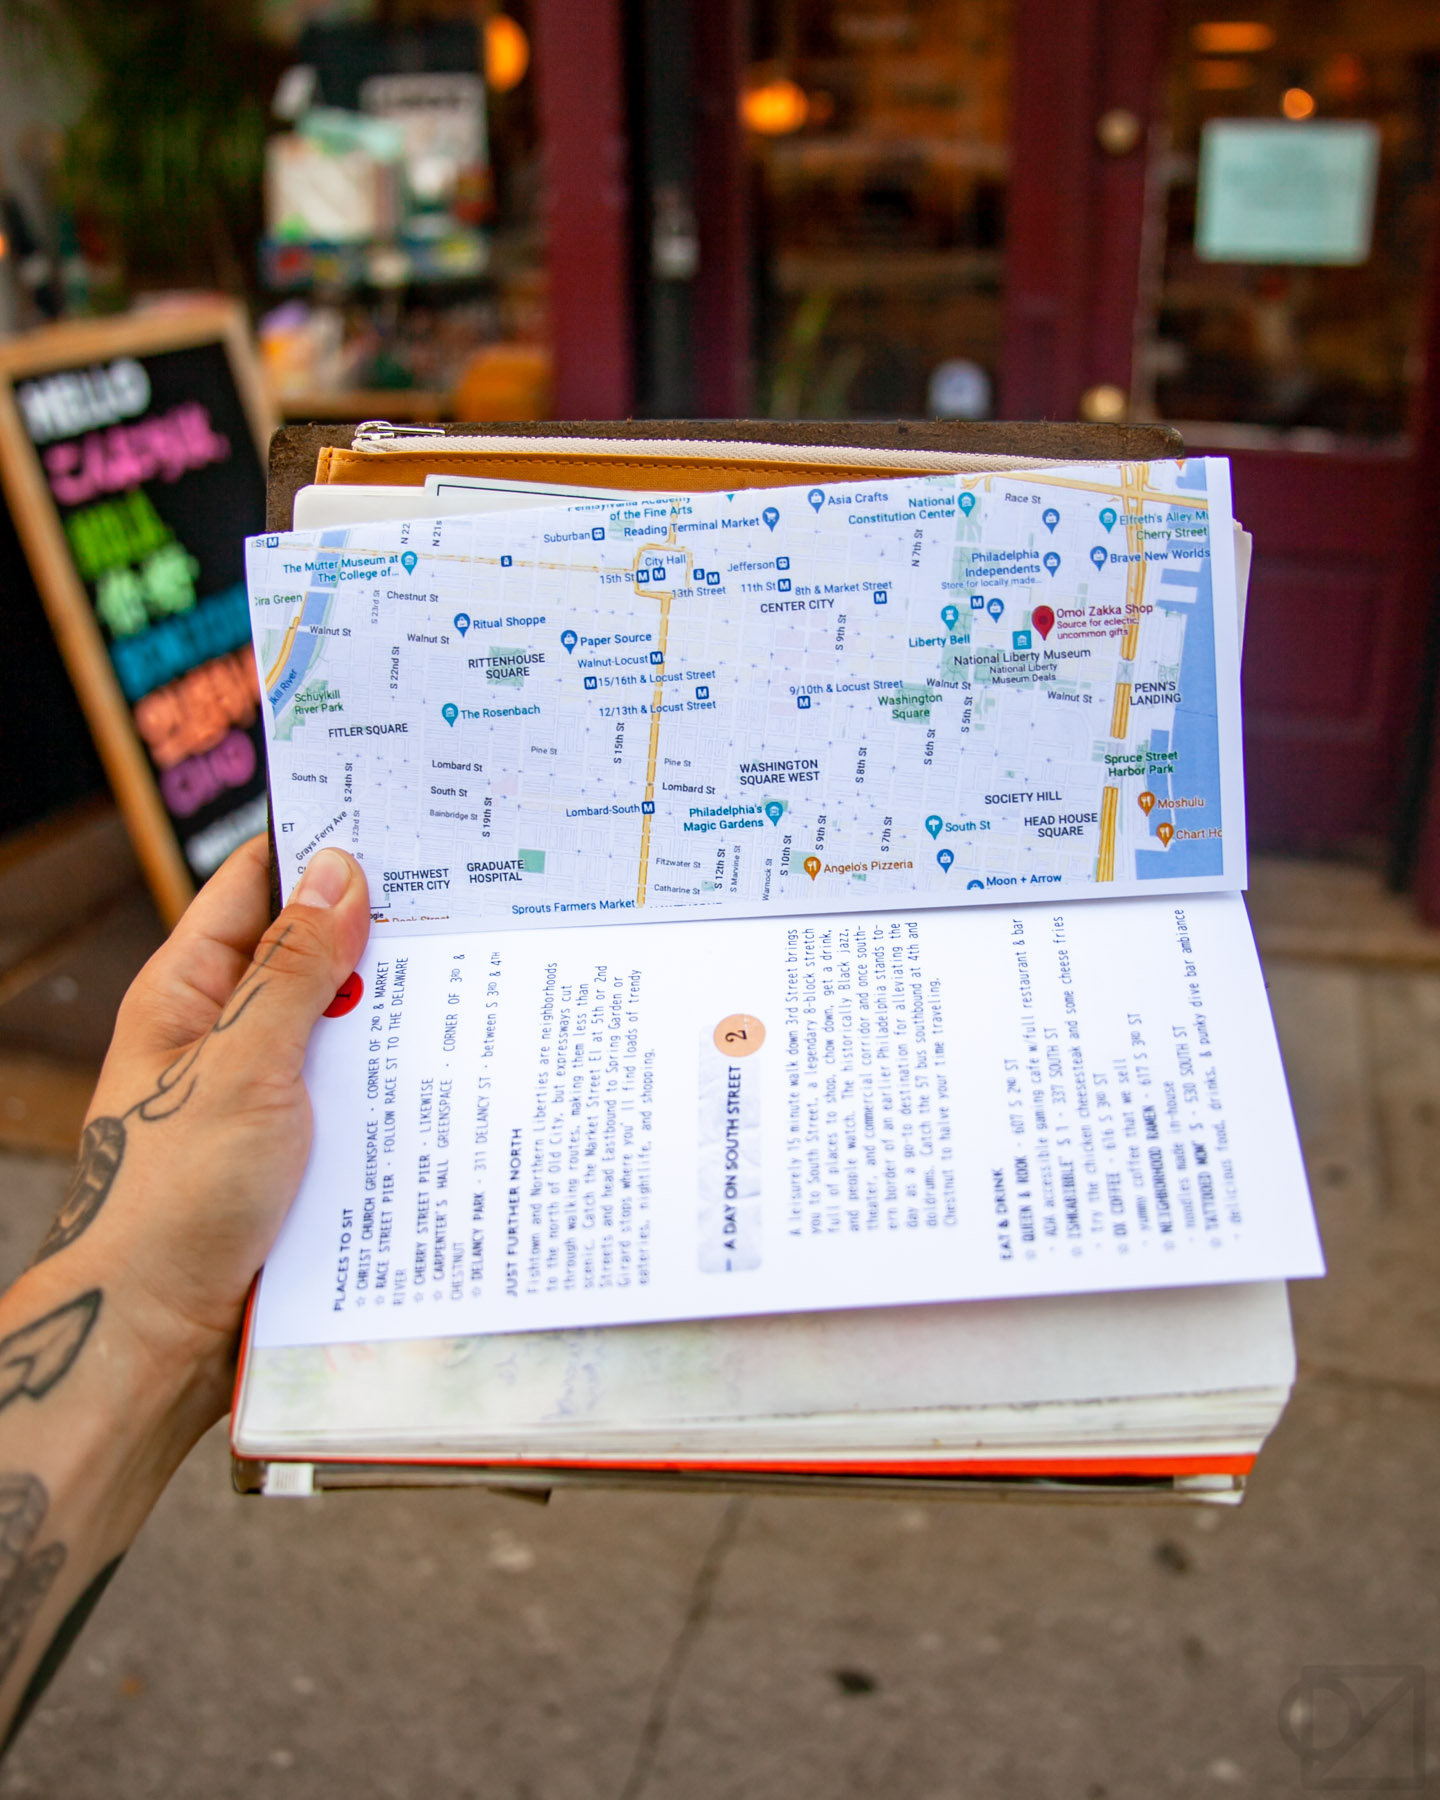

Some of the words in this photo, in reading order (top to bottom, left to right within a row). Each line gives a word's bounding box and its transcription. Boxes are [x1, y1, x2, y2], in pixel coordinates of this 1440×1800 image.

[828, 495, 852, 505] Asia
[855, 492, 888, 503] Crafts
[909, 496, 955, 508] National
[1005, 493, 1029, 503] Race
[1032, 496, 1041, 504] St
[610, 512, 620, 521] of
[624, 510, 641, 519] the
[644, 509, 667, 519] Fine
[670, 506, 693, 516] Arts
[849, 511, 916, 525] Constitution
[919, 509, 955, 520] Center
[1166, 512, 1192, 523] Alley
[624, 525, 667, 537] Reading
[672, 520, 718, 532] Terminal
[722, 517, 759, 529] Market
[1137, 530, 1171, 541] Cherry
[1175, 527, 1207, 538] Street
[544, 531, 590, 543] Suburban
[645, 556, 663, 567] City
[666, 554, 686, 564] Hall
[972, 550, 1039, 563] Philadelphia
[1110, 552, 1141, 563] Brave
[1145, 551, 1168, 561] New
[1172, 548, 1210, 560] Worlds
[283, 564, 302, 573] The
[342, 556, 386, 567] Museum
[390, 555, 398, 563] at
[727, 559, 775, 572] Jefferson
[965, 564, 1040, 577] Independents
[318, 573, 336, 583] The
[340, 569, 378, 581] College
[673, 589, 693, 598] 13th
[697, 586, 726, 596] Street
[795, 586, 811, 595] 8th
[815, 585, 821, 594] &
[824, 583, 859, 594] Market
[863, 581, 892, 591] Street
[761, 601, 805, 613] CENTER
[809, 599, 834, 610] CITY
[1056, 607, 1085, 618] Omoi
[1089, 605, 1122, 617] Zakka
[1125, 603, 1153, 616] Shop
[473, 618, 502, 629] Ritual
[506, 616, 546, 628] Shoppe
[1057, 620, 1087, 629] Source
[1090, 618, 1101, 627] for
[1104, 616, 1139, 627] eclectic,
[581, 636, 610, 647] Paper
[615, 632, 652, 644] Source
[1057, 629, 1107, 640] uncommon
[1110, 627, 1128, 638] gifts
[909, 637, 946, 648] Liberty
[950, 635, 970, 645] Bell
[468, 653, 545, 669] RITTENHOUSE
[578, 655, 648, 668] Walnut-Locust
[954, 653, 999, 666] National
[1003, 652, 1040, 663] Liberty
[1044, 649, 1091, 659] Museum
[486, 667, 530, 679] SQUARE
[598, 676, 637, 688] 15/16th
[640, 675, 647, 683] &
[649, 673, 683, 683] Locust
[686, 671, 715, 680] Street
[790, 684, 823, 696] 9/10th
[826, 684, 833, 693] &
[836, 682, 870, 693] Locust
[873, 680, 903, 690] Street
[1135, 681, 1176, 693] PENN'S
[295, 690, 341, 703] Schuylkill
[878, 693, 943, 707] Washington
[1130, 693, 1181, 705] LANDING
[295, 704, 318, 715] River
[322, 702, 344, 713] Park
[461, 709, 480, 719] The
[483, 705, 540, 718] Rosenbach
[892, 709, 930, 720] Square
[329, 728, 364, 738] FITLER
[366, 723, 408, 735] SQUARE
[1105, 753, 1142, 766] Spruce
[1146, 751, 1178, 761] Street
[740, 759, 818, 773] WASHINGTON
[1109, 766, 1145, 777] Harbor
[1149, 764, 1174, 775] Park
[740, 773, 785, 786] SQUARE
[788, 771, 820, 782] WEST
[985, 792, 1033, 804] SOCIETY
[1037, 791, 1062, 801] HILL
[1158, 798, 1204, 809] Moshulu
[566, 804, 640, 818] Lombard-South
[689, 804, 762, 818] Philadelphia's
[684, 820, 716, 832] Magic
[720, 818, 764, 830] Gardens
[945, 822, 977, 832] South
[980, 820, 990, 830] St
[1024, 816, 1055, 827] HEAD
[1059, 813, 1098, 824] HOUSE
[1038, 826, 1083, 838] SQUARE
[467, 860, 524, 872] GRADUATE
[824, 862, 868, 874] Angelo's
[871, 860, 913, 870] Pizzeria
[384, 868, 449, 881] SOUTHWEST
[469, 872, 522, 884] HOSPITAL
[986, 876, 1016, 887] Moon
[1030, 874, 1062, 884] Arrow
[383, 882, 424, 893] CENTER
[427, 881, 450, 891] CITY
[512, 903, 551, 915] Sprouts
[554, 901, 596, 913] Farmers
[599, 899, 635, 910] Market
[1010, 919, 1024, 935] bar
[784, 929, 800, 962] brings
[373, 962, 390, 998] MARKET
[390, 958, 409, 1006] DELAWARE
[784, 968, 799, 1002] Street
[1014, 952, 1034, 1008] restaurant
[389, 1012, 403, 1030] THE
[785, 1007, 799, 1025] 3rd
[370, 1016, 383, 1031] 2ND
[387, 1037, 400, 1049] TO
[724, 1029, 749, 1043] 2
[370, 1039, 382, 1051] OF
[386, 1057, 399, 1069] ST
[367, 1057, 380, 1099] CORNER
[384, 1076, 398, 1104] RACE
[727, 1066, 742, 1114] STREET
[383, 1111, 397, 1153] FOLLOW
[724, 1119, 740, 1170] SOUTH
[364, 1121, 379, 1191] GREENSPACE
[508, 1128, 523, 1180] NORTH
[381, 1174, 395, 1202] PIER
[724, 1176, 738, 1199] ON
[342, 1208, 354, 1228] SIT
[361, 1198, 375, 1240] CHURCH
[507, 1186, 521, 1255] FURTHER
[723, 1205, 738, 1234] DAY
[379, 1211, 393, 1253] STREET
[340, 1233, 352, 1251] TO
[723, 1240, 736, 1249] A
[356, 1248, 372, 1290] CHRIST
[375, 1260, 390, 1288] RACE
[333, 1256, 351, 1311] PLACES
[506, 1262, 519, 1297] JUST
